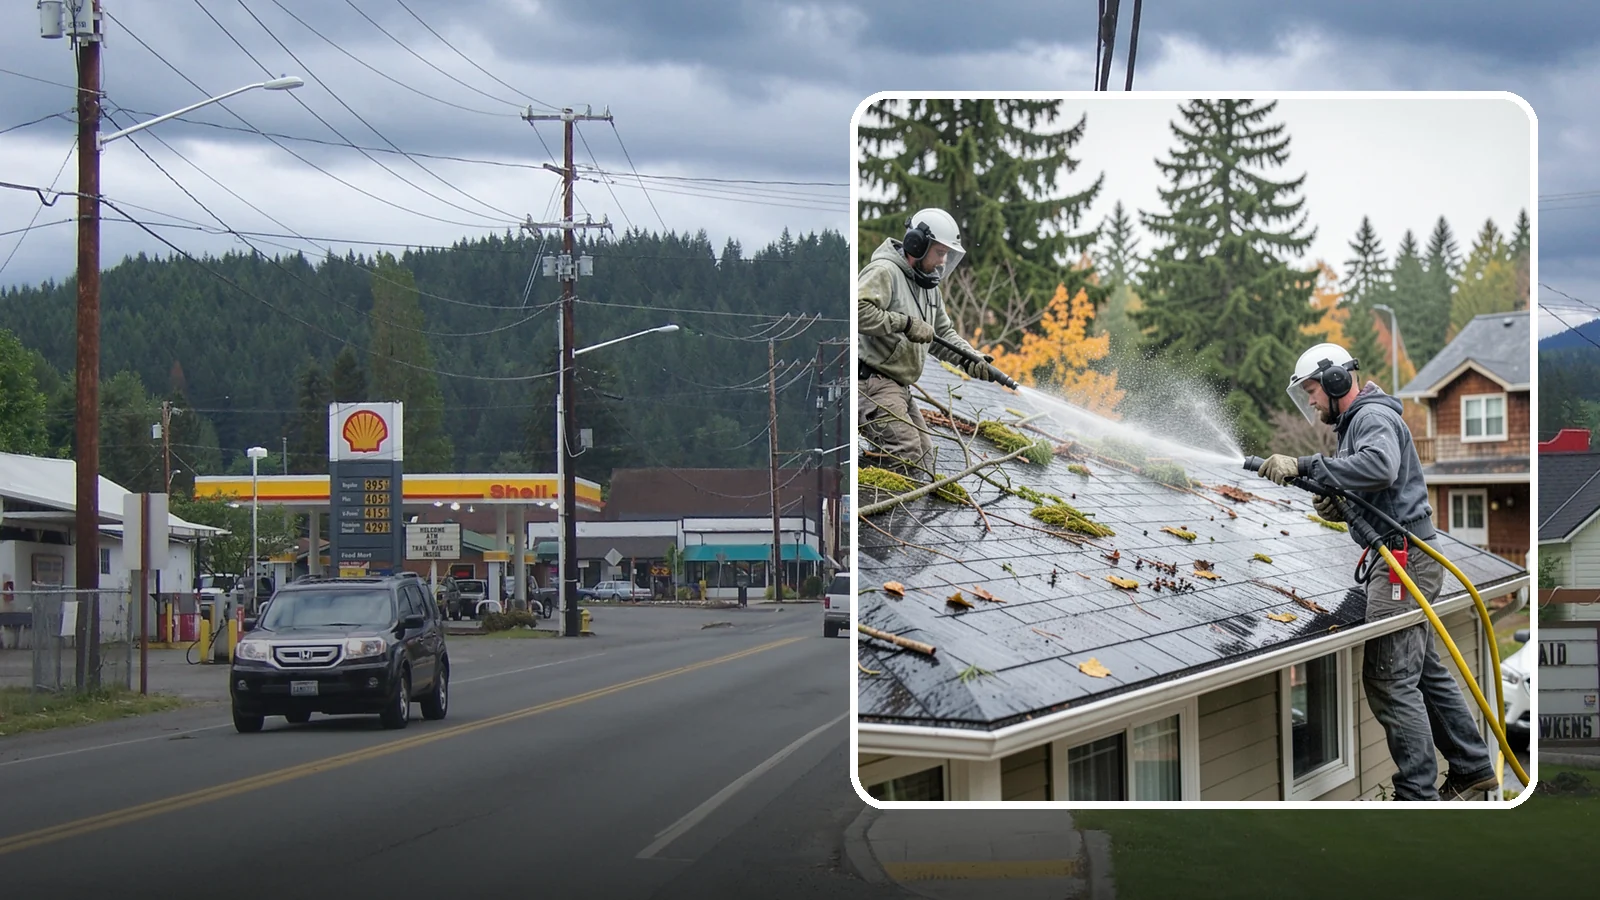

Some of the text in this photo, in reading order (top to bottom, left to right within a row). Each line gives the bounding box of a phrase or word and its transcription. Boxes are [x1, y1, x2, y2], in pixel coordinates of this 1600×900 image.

[366, 480, 383, 490] 395
[490, 484, 547, 499] Shell
[366, 494, 383, 504] 405
[366, 508, 383, 518] 415
[366, 522, 383, 532] 429
[1539, 643, 1567, 665] AID
